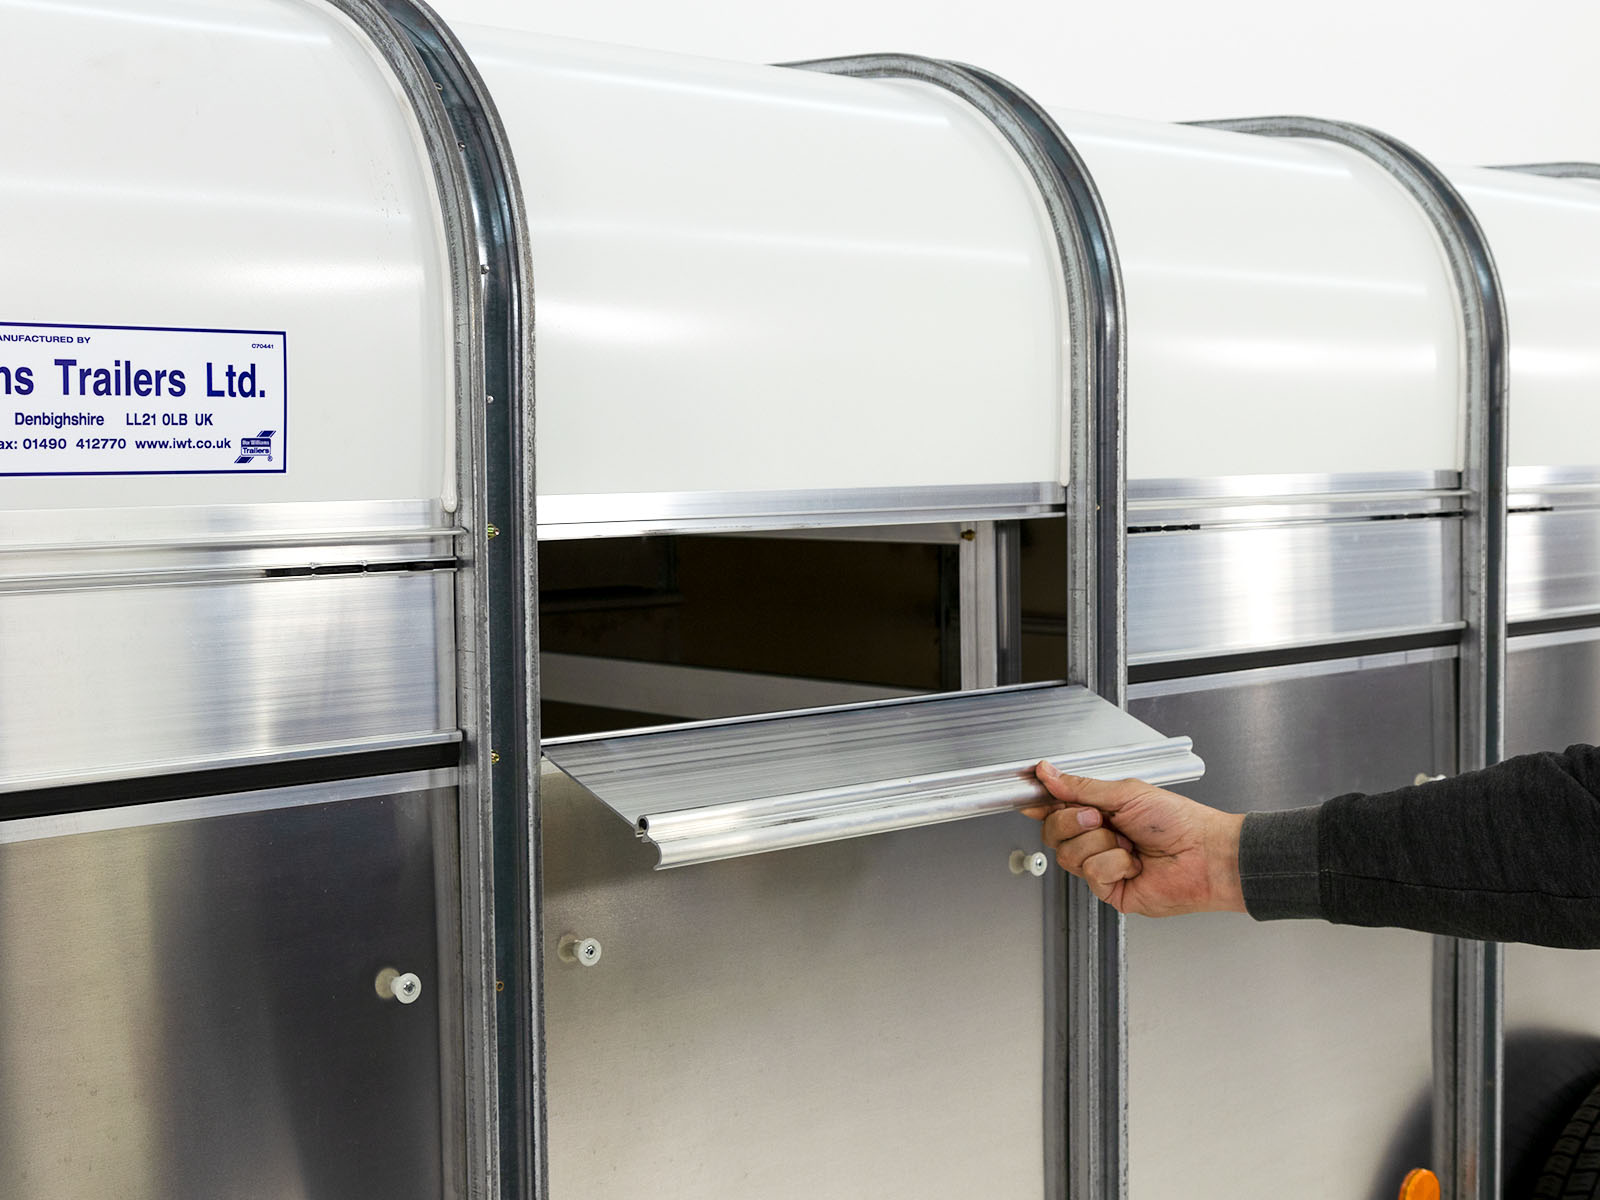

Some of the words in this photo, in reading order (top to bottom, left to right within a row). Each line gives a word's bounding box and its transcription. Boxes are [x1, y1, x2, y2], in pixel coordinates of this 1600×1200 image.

[77, 337, 91, 345] BY
[54, 359, 186, 397] Trailers
[207, 362, 266, 398] Ltd.
[14, 412, 105, 429] Denbighshire
[126, 413, 157, 426] LL21
[162, 413, 188, 426] 0LB
[195, 413, 213, 426] UK
[22, 438, 67, 450] 01490
[76, 438, 127, 450] 412770
[135, 438, 232, 450] www.iwt.co.uk
